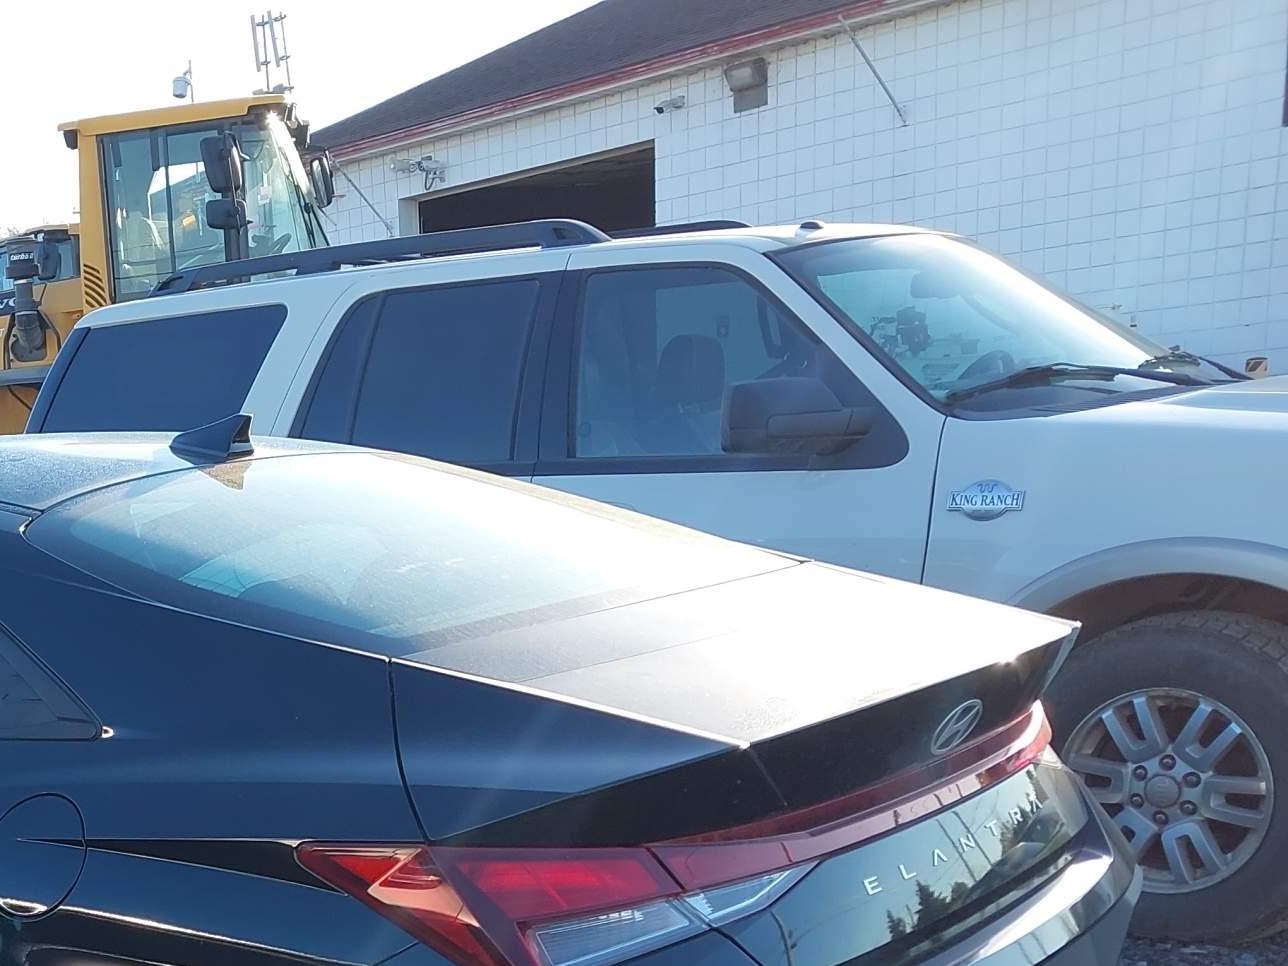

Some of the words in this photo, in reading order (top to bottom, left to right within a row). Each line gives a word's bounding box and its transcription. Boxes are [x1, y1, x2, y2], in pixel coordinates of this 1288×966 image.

[950, 494, 978, 507] KING
[980, 493, 1021, 507] RANCH
[863, 799, 1044, 896] ELANTRA
